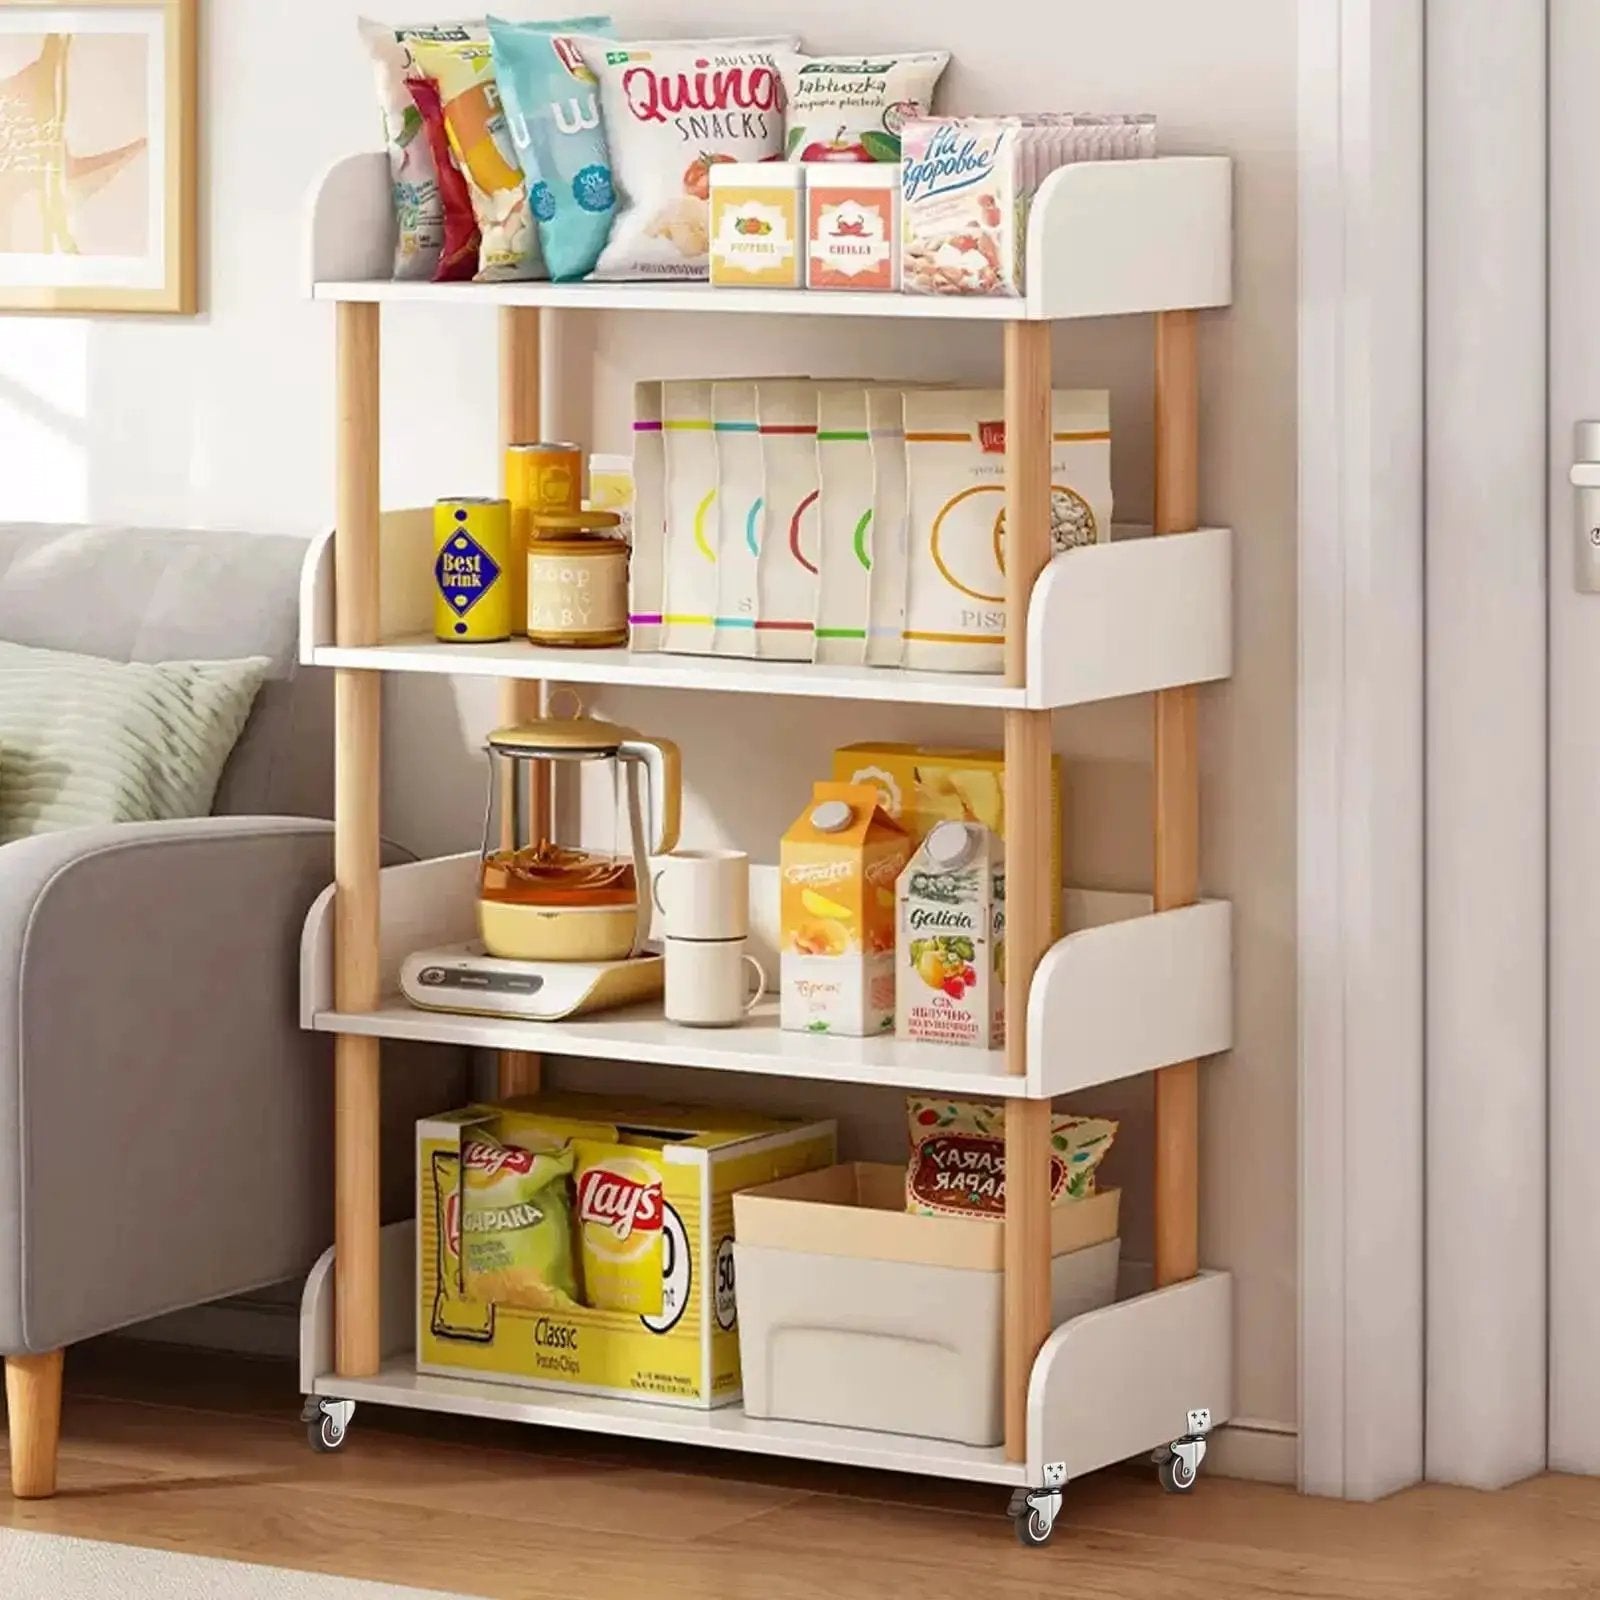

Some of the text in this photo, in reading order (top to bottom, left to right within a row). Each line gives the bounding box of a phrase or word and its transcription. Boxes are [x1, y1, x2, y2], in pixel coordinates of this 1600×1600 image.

[675, 112, 768, 141] SNACKS
[442, 552, 482, 573] Best
[442, 571, 483, 588] Drink
[909, 907, 974, 930] Galicia
[719, 1253, 735, 1292] 50
[534, 1316, 578, 1350] Classic
